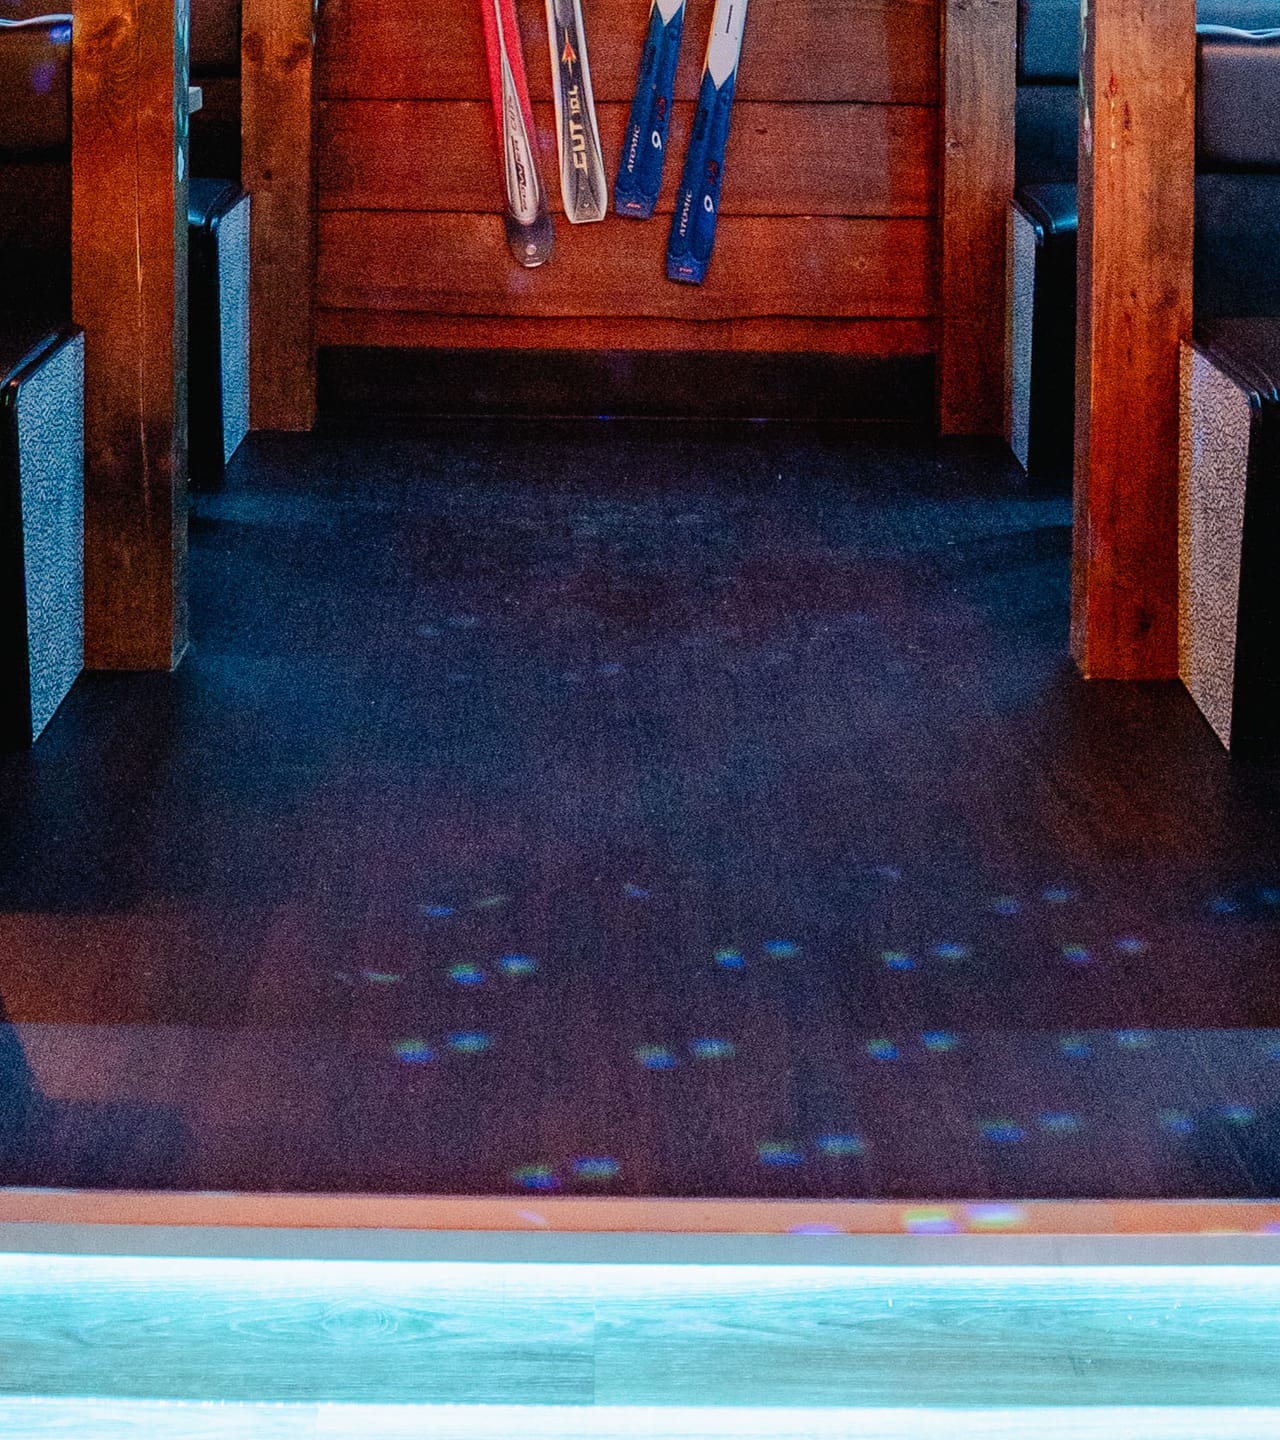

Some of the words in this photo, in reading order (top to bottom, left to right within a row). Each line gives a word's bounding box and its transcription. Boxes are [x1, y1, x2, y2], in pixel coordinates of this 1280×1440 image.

[570, 120, 588, 176] CUT
[627, 123, 641, 173] ATOMIC
[679, 188, 693, 238] ATOMIC
